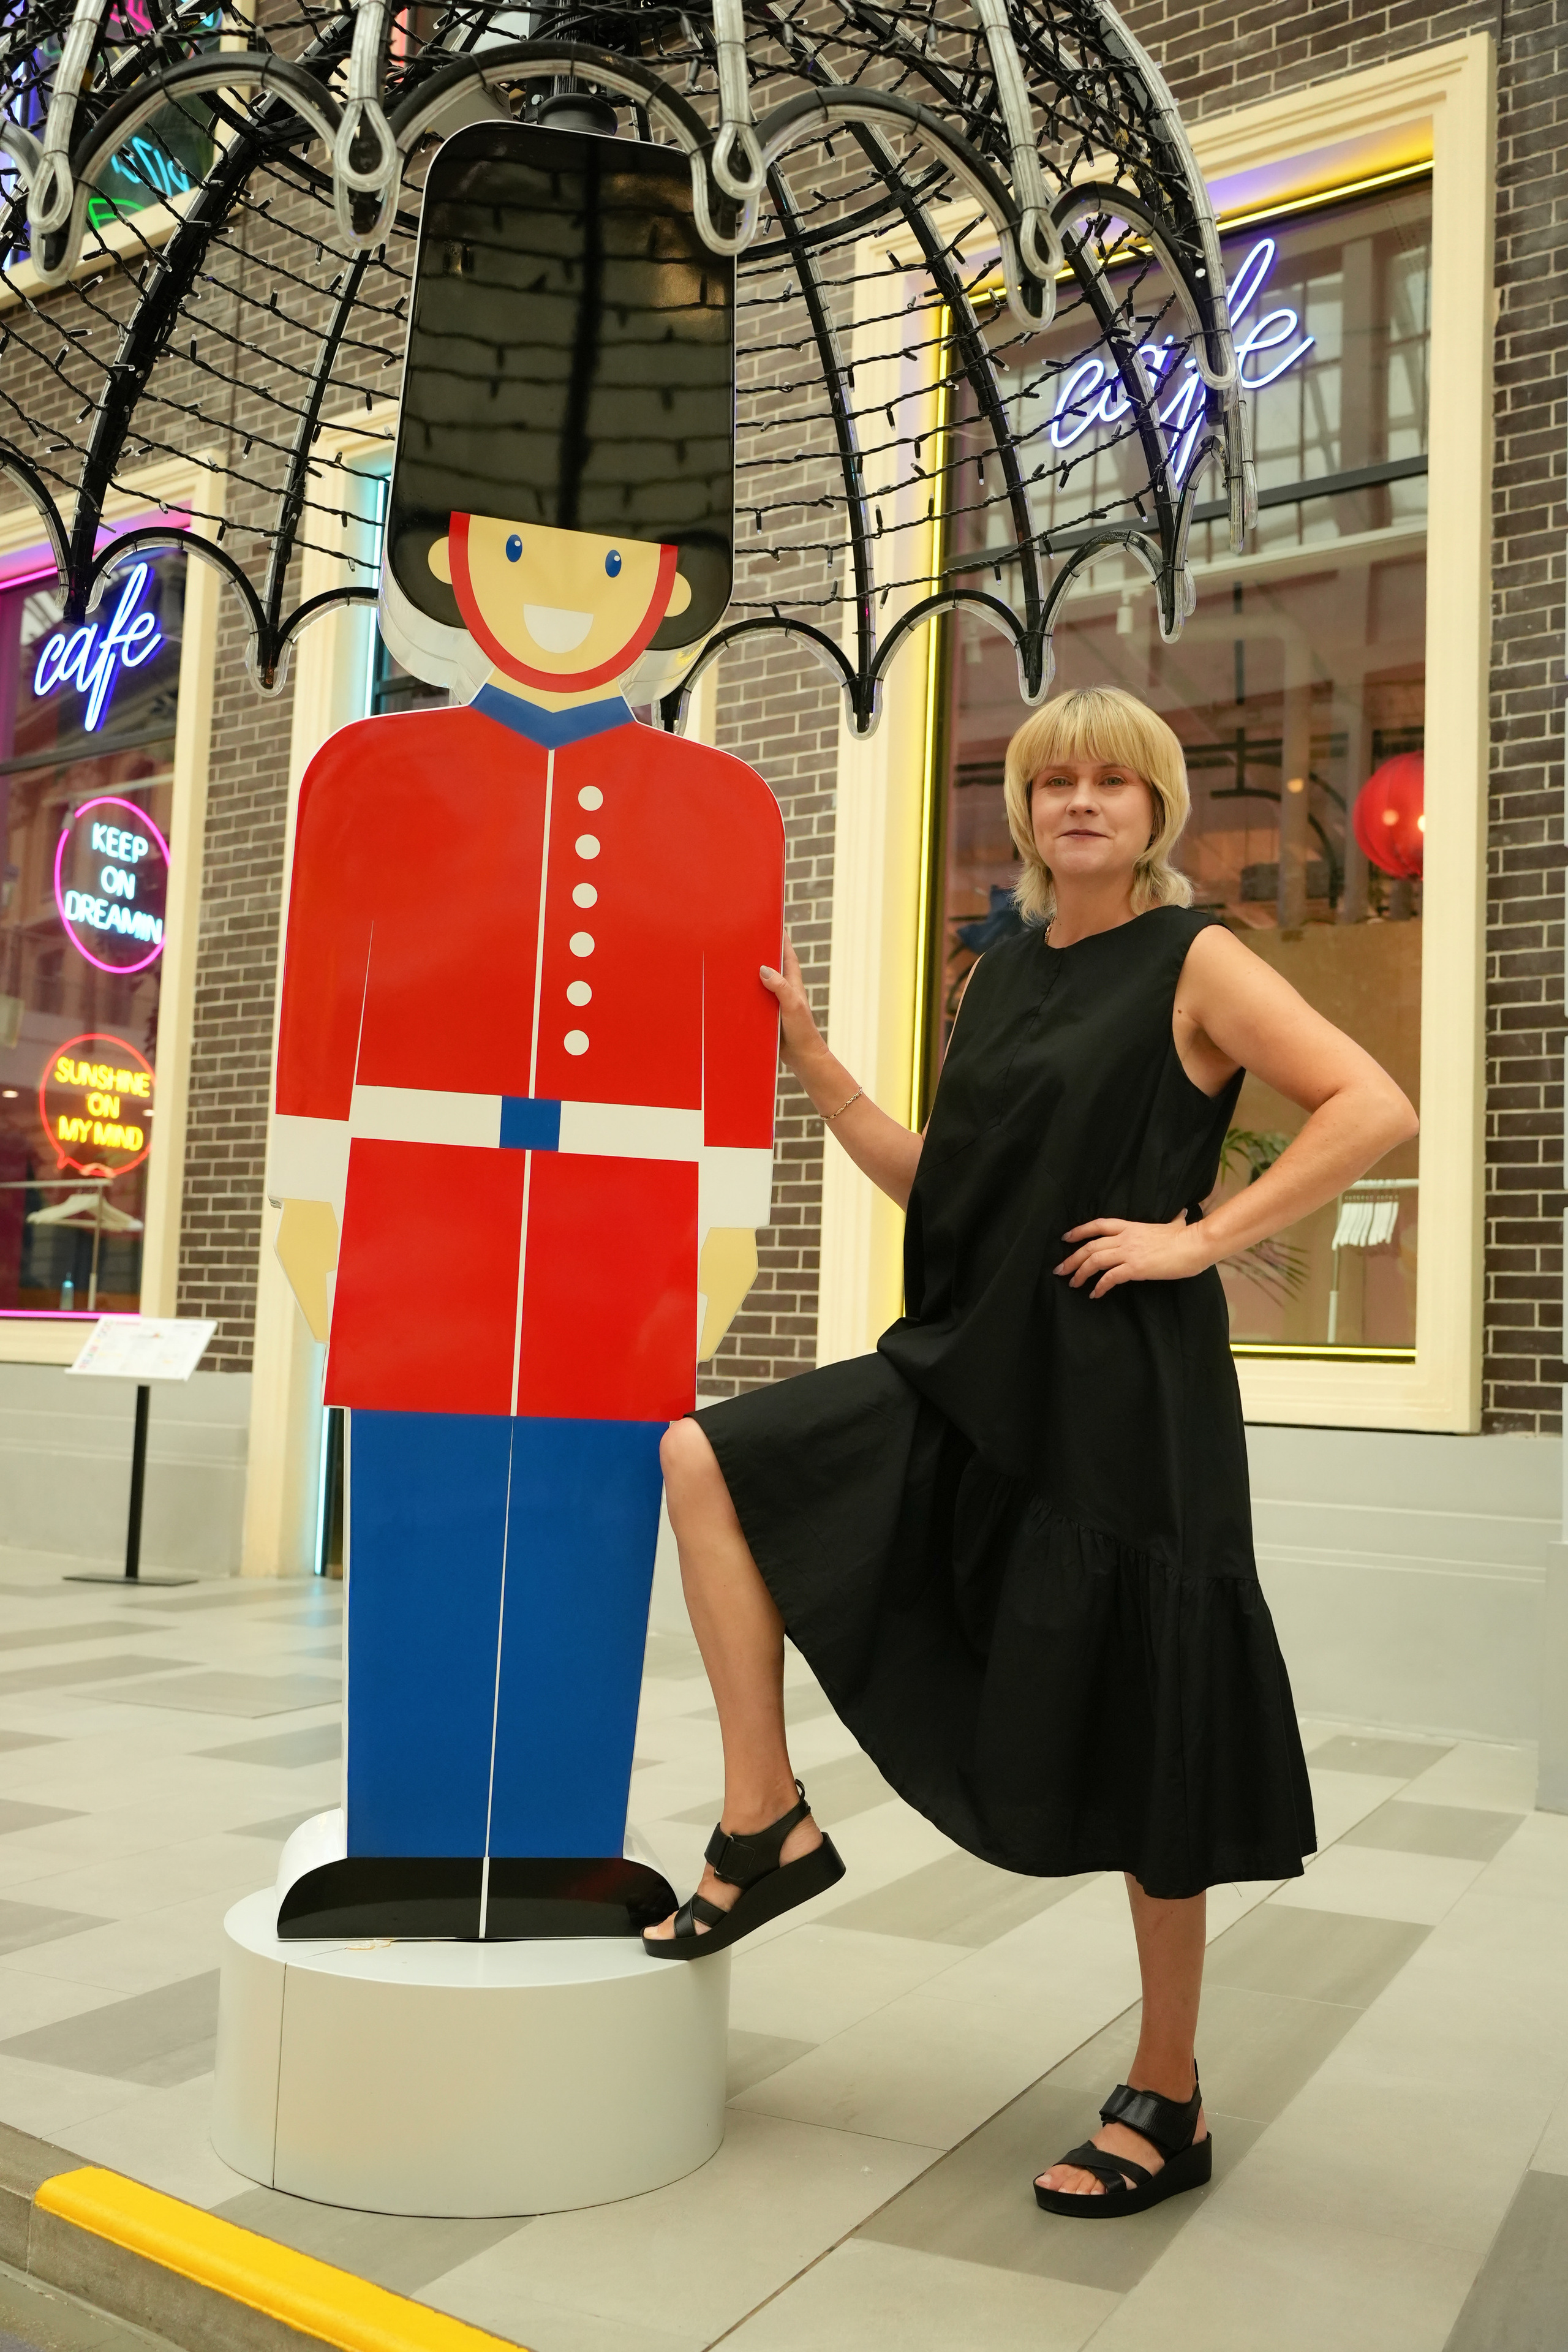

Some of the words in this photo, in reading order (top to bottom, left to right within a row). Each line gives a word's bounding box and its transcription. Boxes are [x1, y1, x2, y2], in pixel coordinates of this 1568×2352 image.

[34, 562, 162, 732] cafe
[92, 822, 149, 864] KEEP
[100, 865, 136, 900] ON
[64, 890, 164, 944] DREAMIN
[55, 1056, 151, 1098] SUNSHINE
[88, 1091, 120, 1119] ON
[58, 1115, 92, 1143] MY
[93, 1121, 143, 1152] MIND
